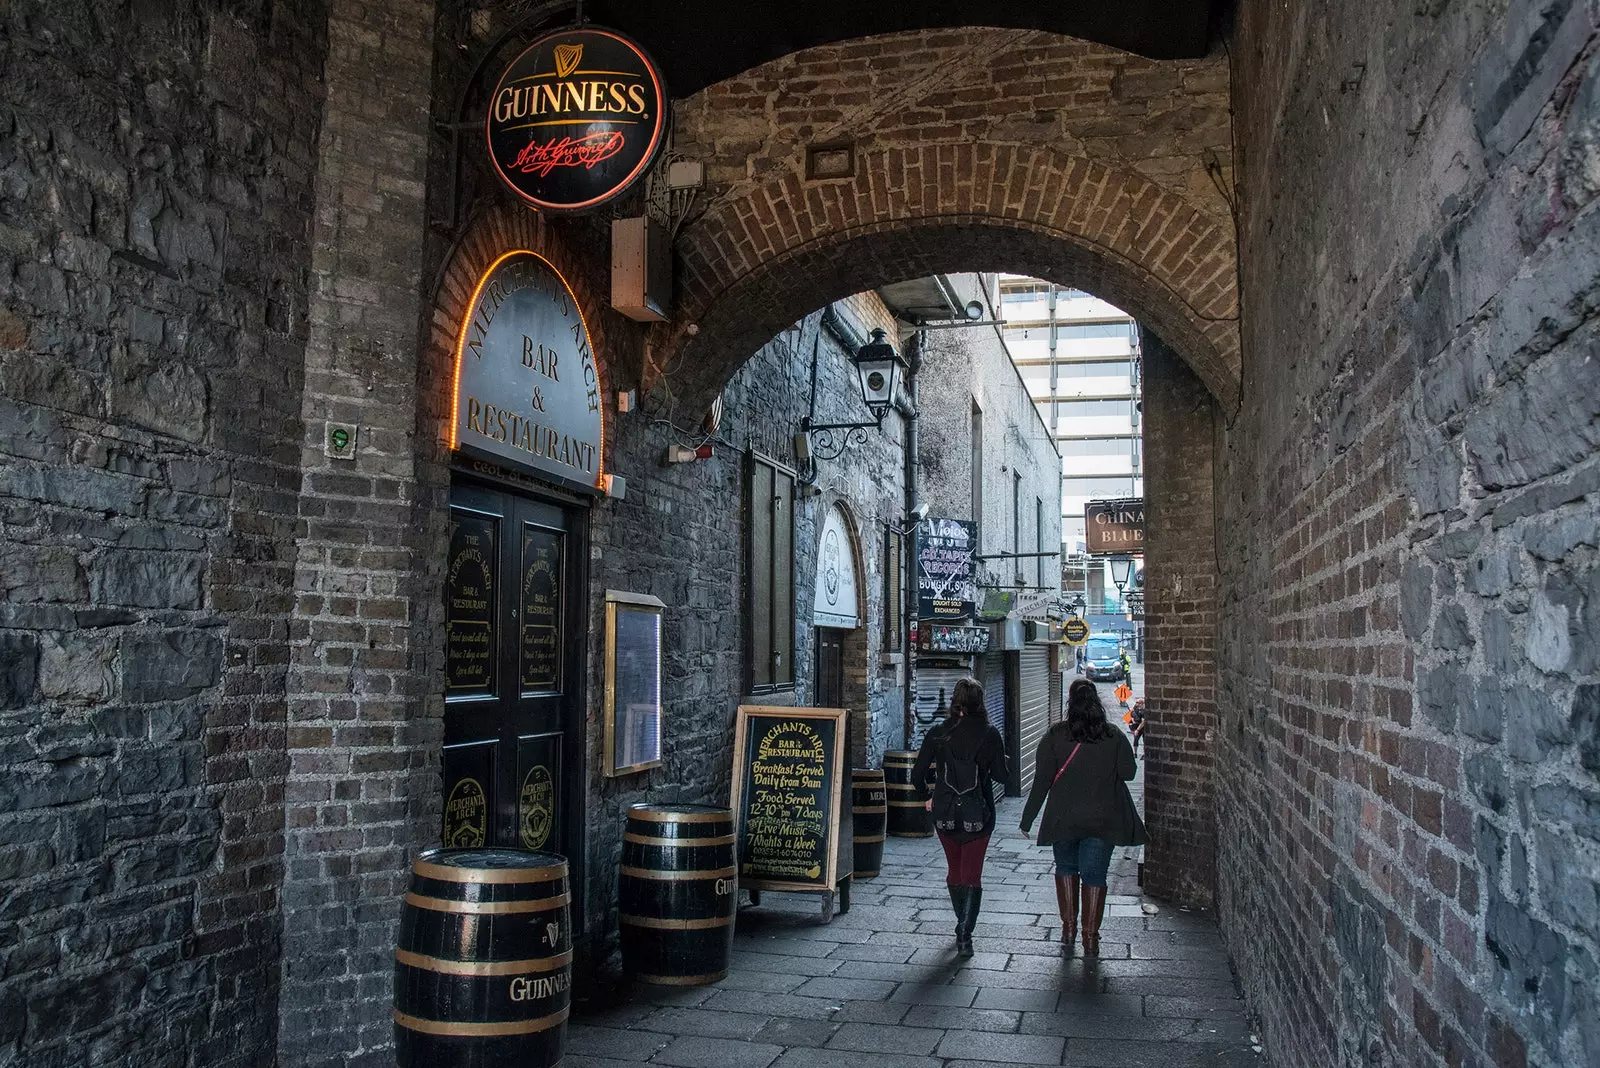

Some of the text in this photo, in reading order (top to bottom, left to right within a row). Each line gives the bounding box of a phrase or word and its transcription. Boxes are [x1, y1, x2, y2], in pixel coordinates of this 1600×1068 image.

[494, 81, 646, 124] GUINNESS
[467, 261, 599, 414] MERCHANTS ARCH
[521, 333, 560, 383] BAR
[532, 385, 545, 413] &
[466, 396, 596, 475] RESTAURANT
[464, 534, 480, 546] THE
[1102, 529, 1143, 542] BLUE
[924, 560, 970, 574] RECORDS
[452, 599, 487, 610] RESTAURANT
[527, 605, 554, 615] RESTAURANT
[758, 721, 825, 763] MERCHANTS ARCH
[778, 740, 795, 748] BAR
[767, 748, 816, 758] RESTAURANT
[752, 761, 824, 777] Breakfast Served
[753, 773, 821, 790] Daily from 9am
[756, 790, 816, 806] Food Served
[455, 807, 476, 820] ARCH
[803, 806, 823, 823] days
[757, 820, 806, 836] Live Music
[747, 833, 755, 846] 7
[754, 834, 782, 848] Nights
[785, 839, 792, 848] a
